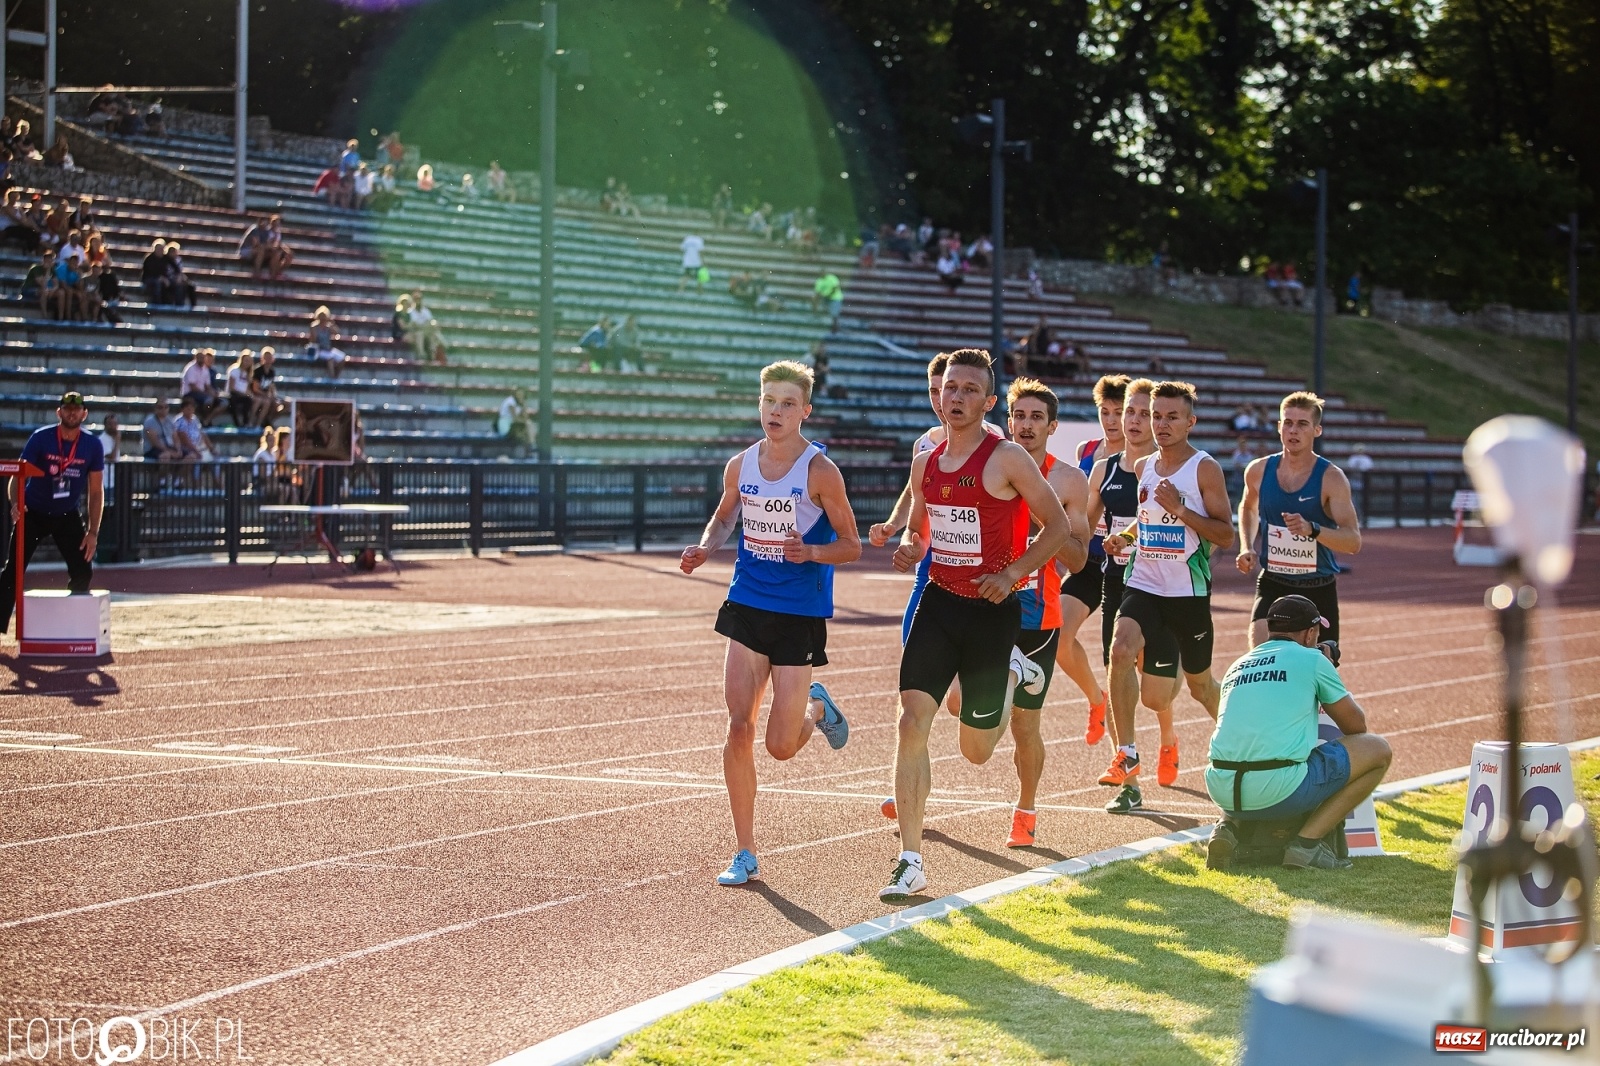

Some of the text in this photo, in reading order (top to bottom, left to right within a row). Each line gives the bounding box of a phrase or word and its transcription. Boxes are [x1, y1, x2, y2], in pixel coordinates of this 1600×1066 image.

[740, 484, 759, 495] AZS
[764, 500, 792, 512] 606
[950, 508, 976, 522] 548
[744, 517, 794, 534] PRZYBYLAK
[1140, 530, 1183, 542] GUSTYNIAK
[1480, 762, 1498, 775] polanik
[1530, 762, 1562, 777] polanik
[1516, 786, 1564, 908] 3
